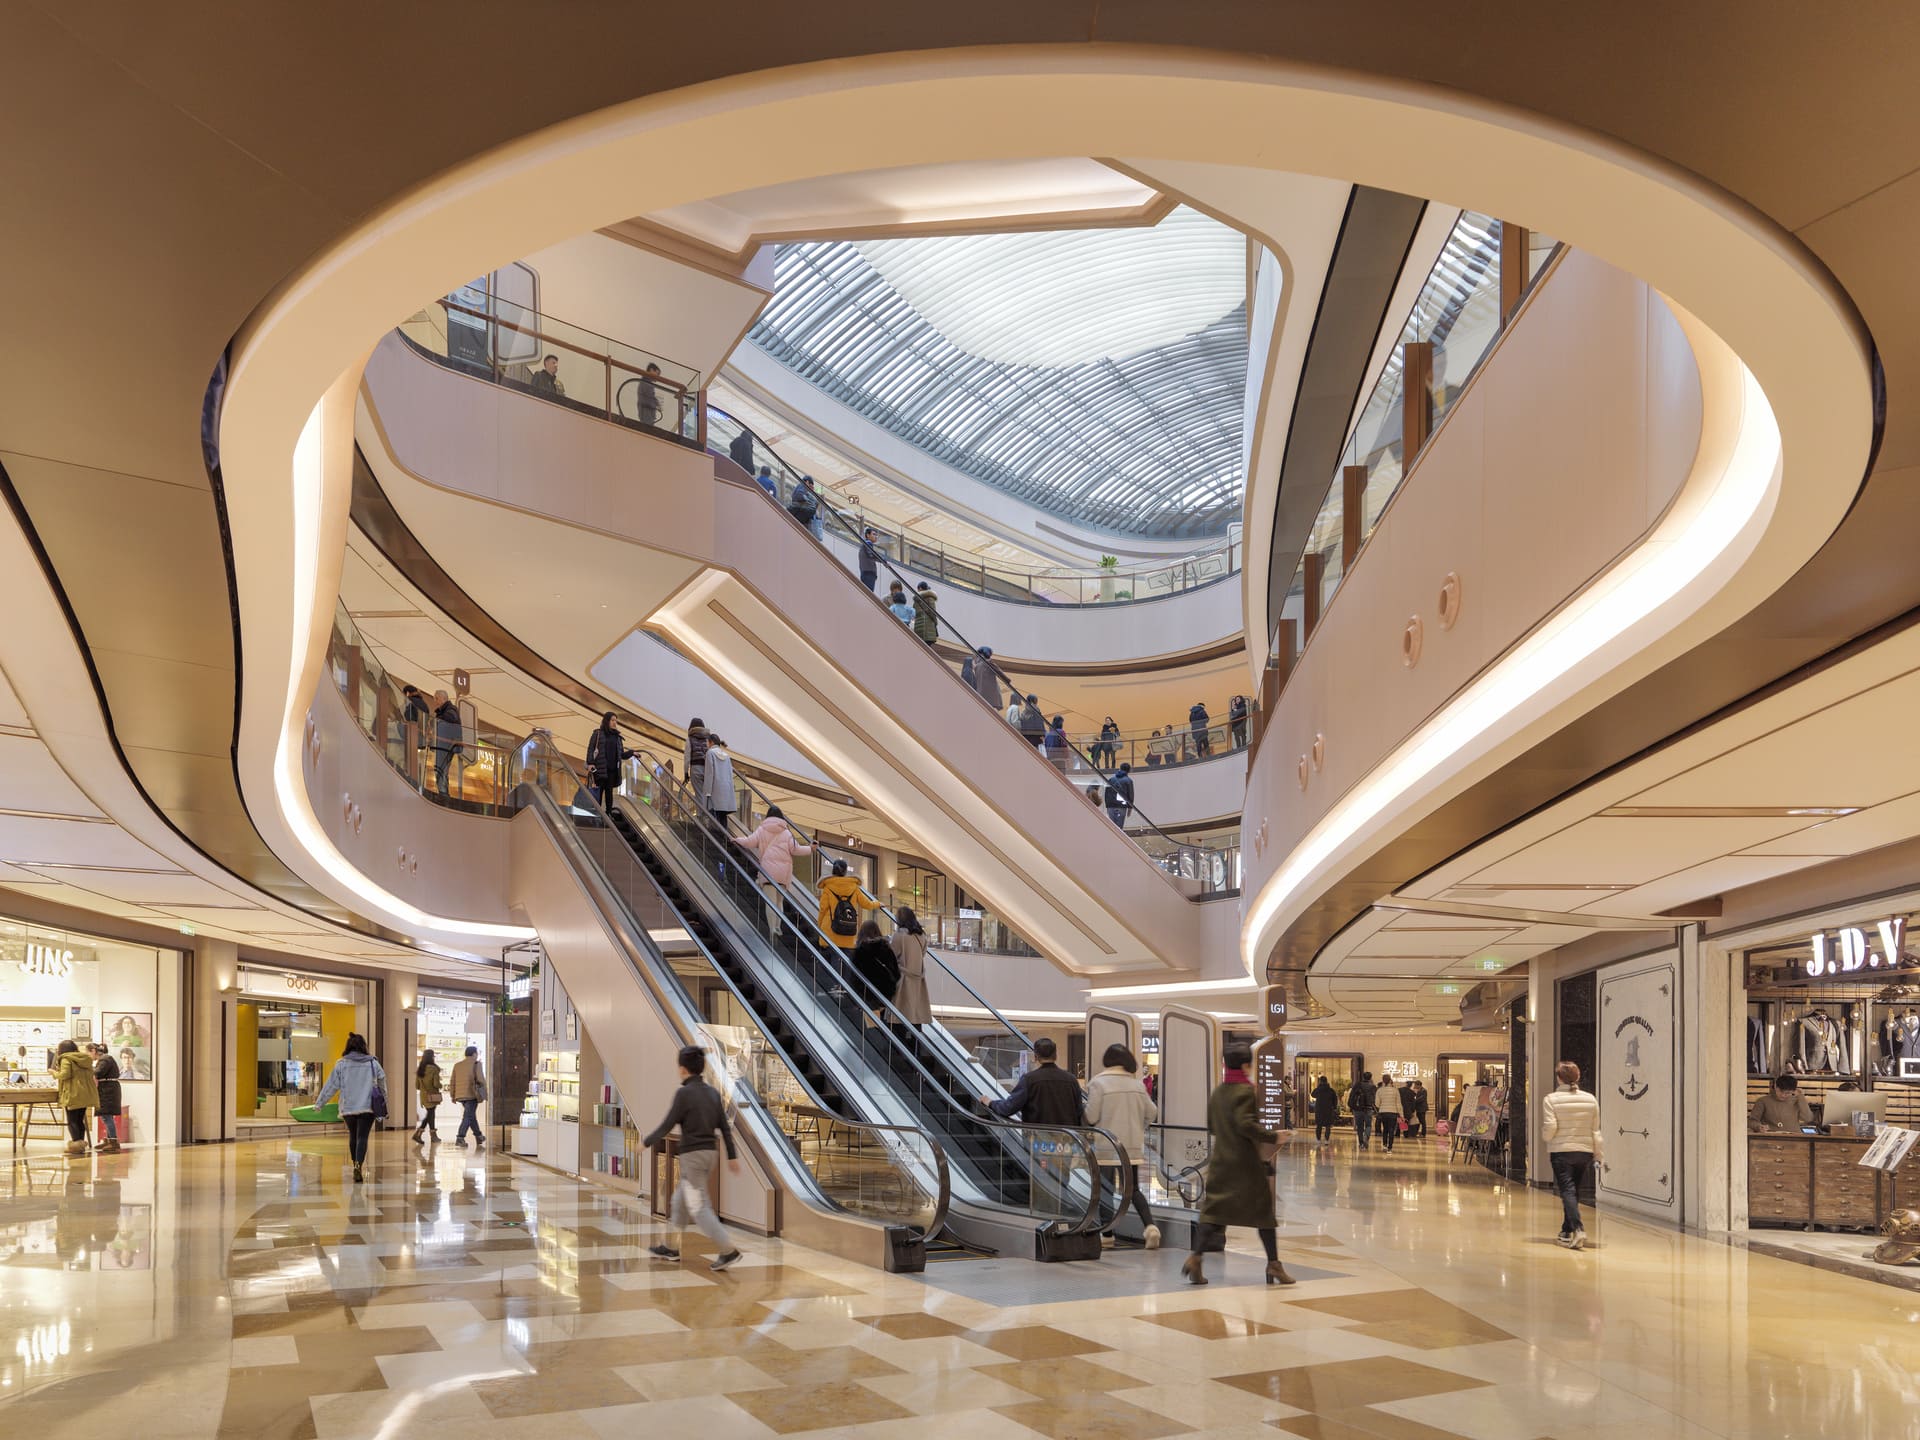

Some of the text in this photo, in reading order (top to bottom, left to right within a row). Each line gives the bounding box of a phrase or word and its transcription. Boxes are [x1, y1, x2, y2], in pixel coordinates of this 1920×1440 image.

[18, 942, 74, 979] JINS
[1806, 918, 1903, 977] J.D.V
[1270, 1003, 1285, 1014] LG1
